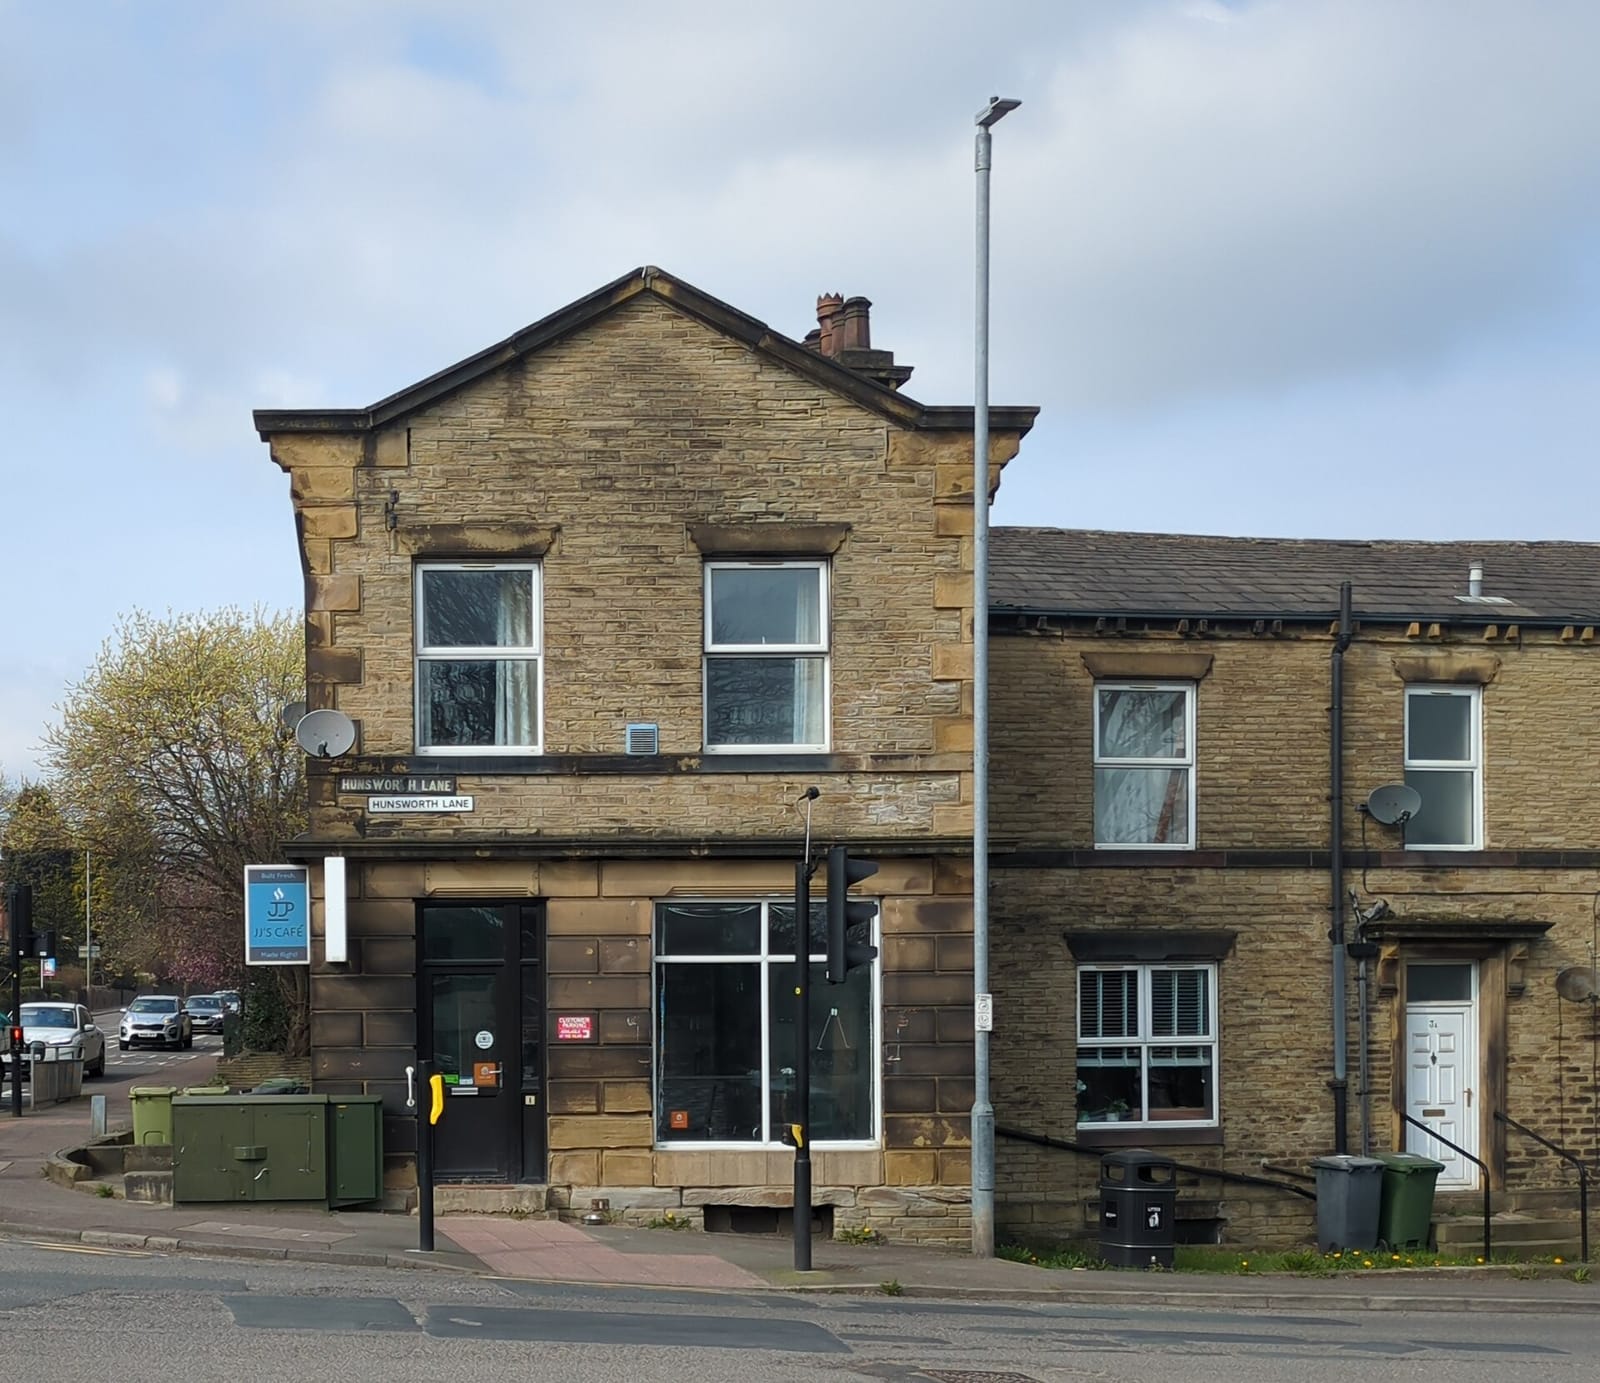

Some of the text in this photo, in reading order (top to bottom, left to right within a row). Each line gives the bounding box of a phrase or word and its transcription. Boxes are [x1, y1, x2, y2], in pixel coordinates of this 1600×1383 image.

[341, 778, 451, 792] HUNSWORH LANE
[372, 799, 470, 809] HUNSWORTH LANE
[254, 924, 304, 938] JJ'S CAFÉ
